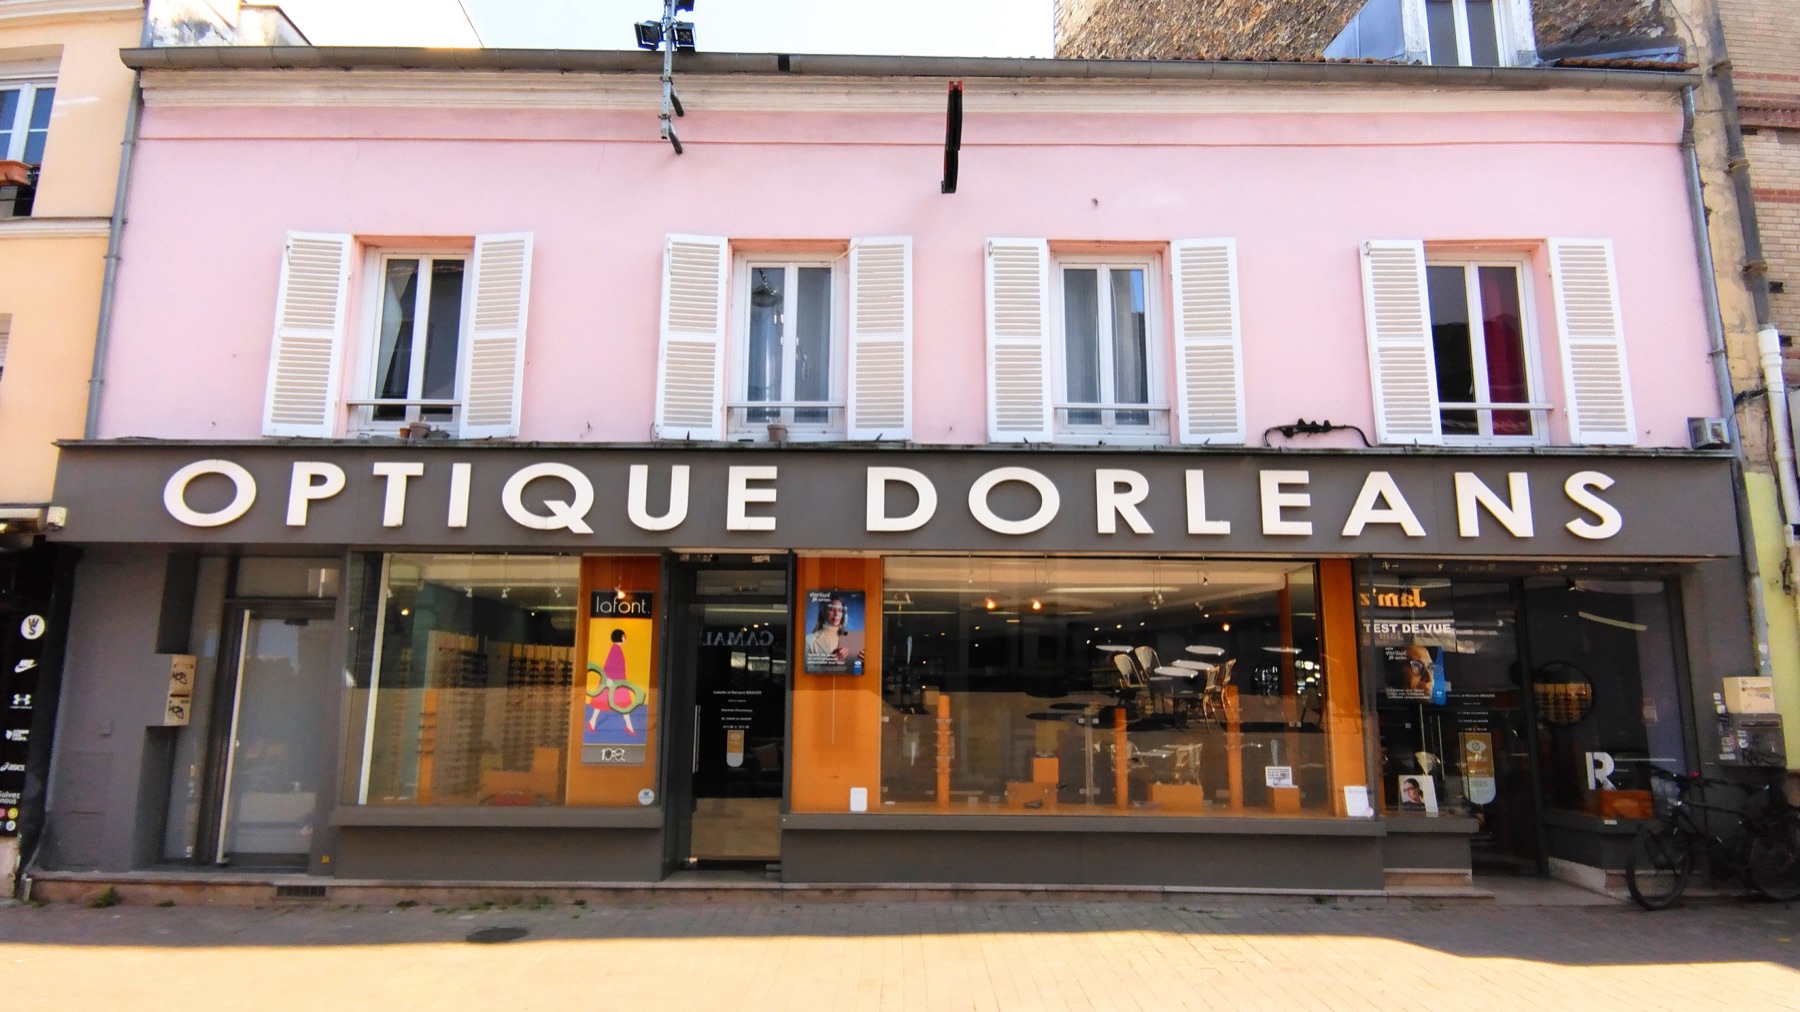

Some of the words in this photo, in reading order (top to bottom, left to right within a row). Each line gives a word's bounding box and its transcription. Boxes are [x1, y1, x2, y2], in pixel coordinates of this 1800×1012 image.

[164, 459, 778, 534] OPTIQUE
[866, 466, 1623, 539] DORLEANS
[1363, 624, 1398, 633] TEST
[1402, 624, 1420, 633] DE
[1423, 624, 1452, 633] VUE
